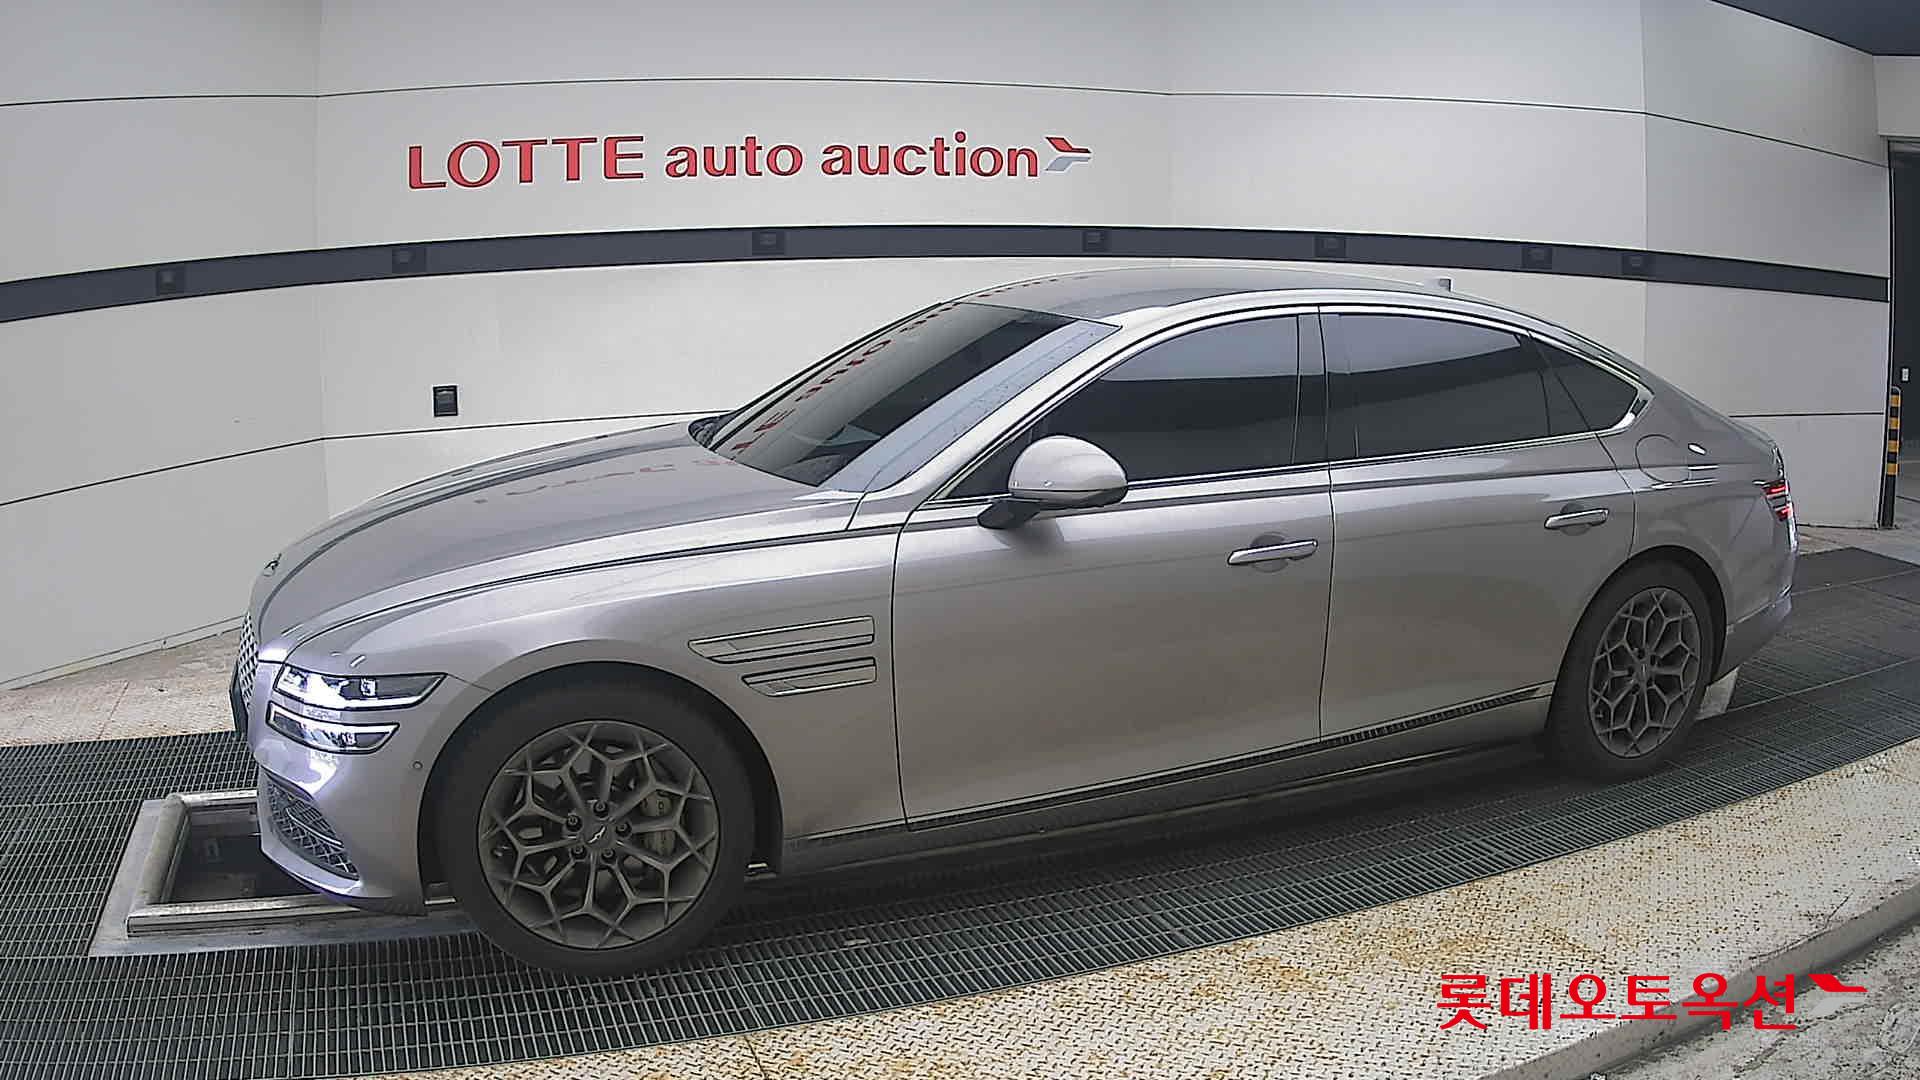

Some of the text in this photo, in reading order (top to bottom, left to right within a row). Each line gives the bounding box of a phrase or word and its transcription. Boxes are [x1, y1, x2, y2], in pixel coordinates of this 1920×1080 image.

[408, 131, 1040, 189] LOTTE auto auction
